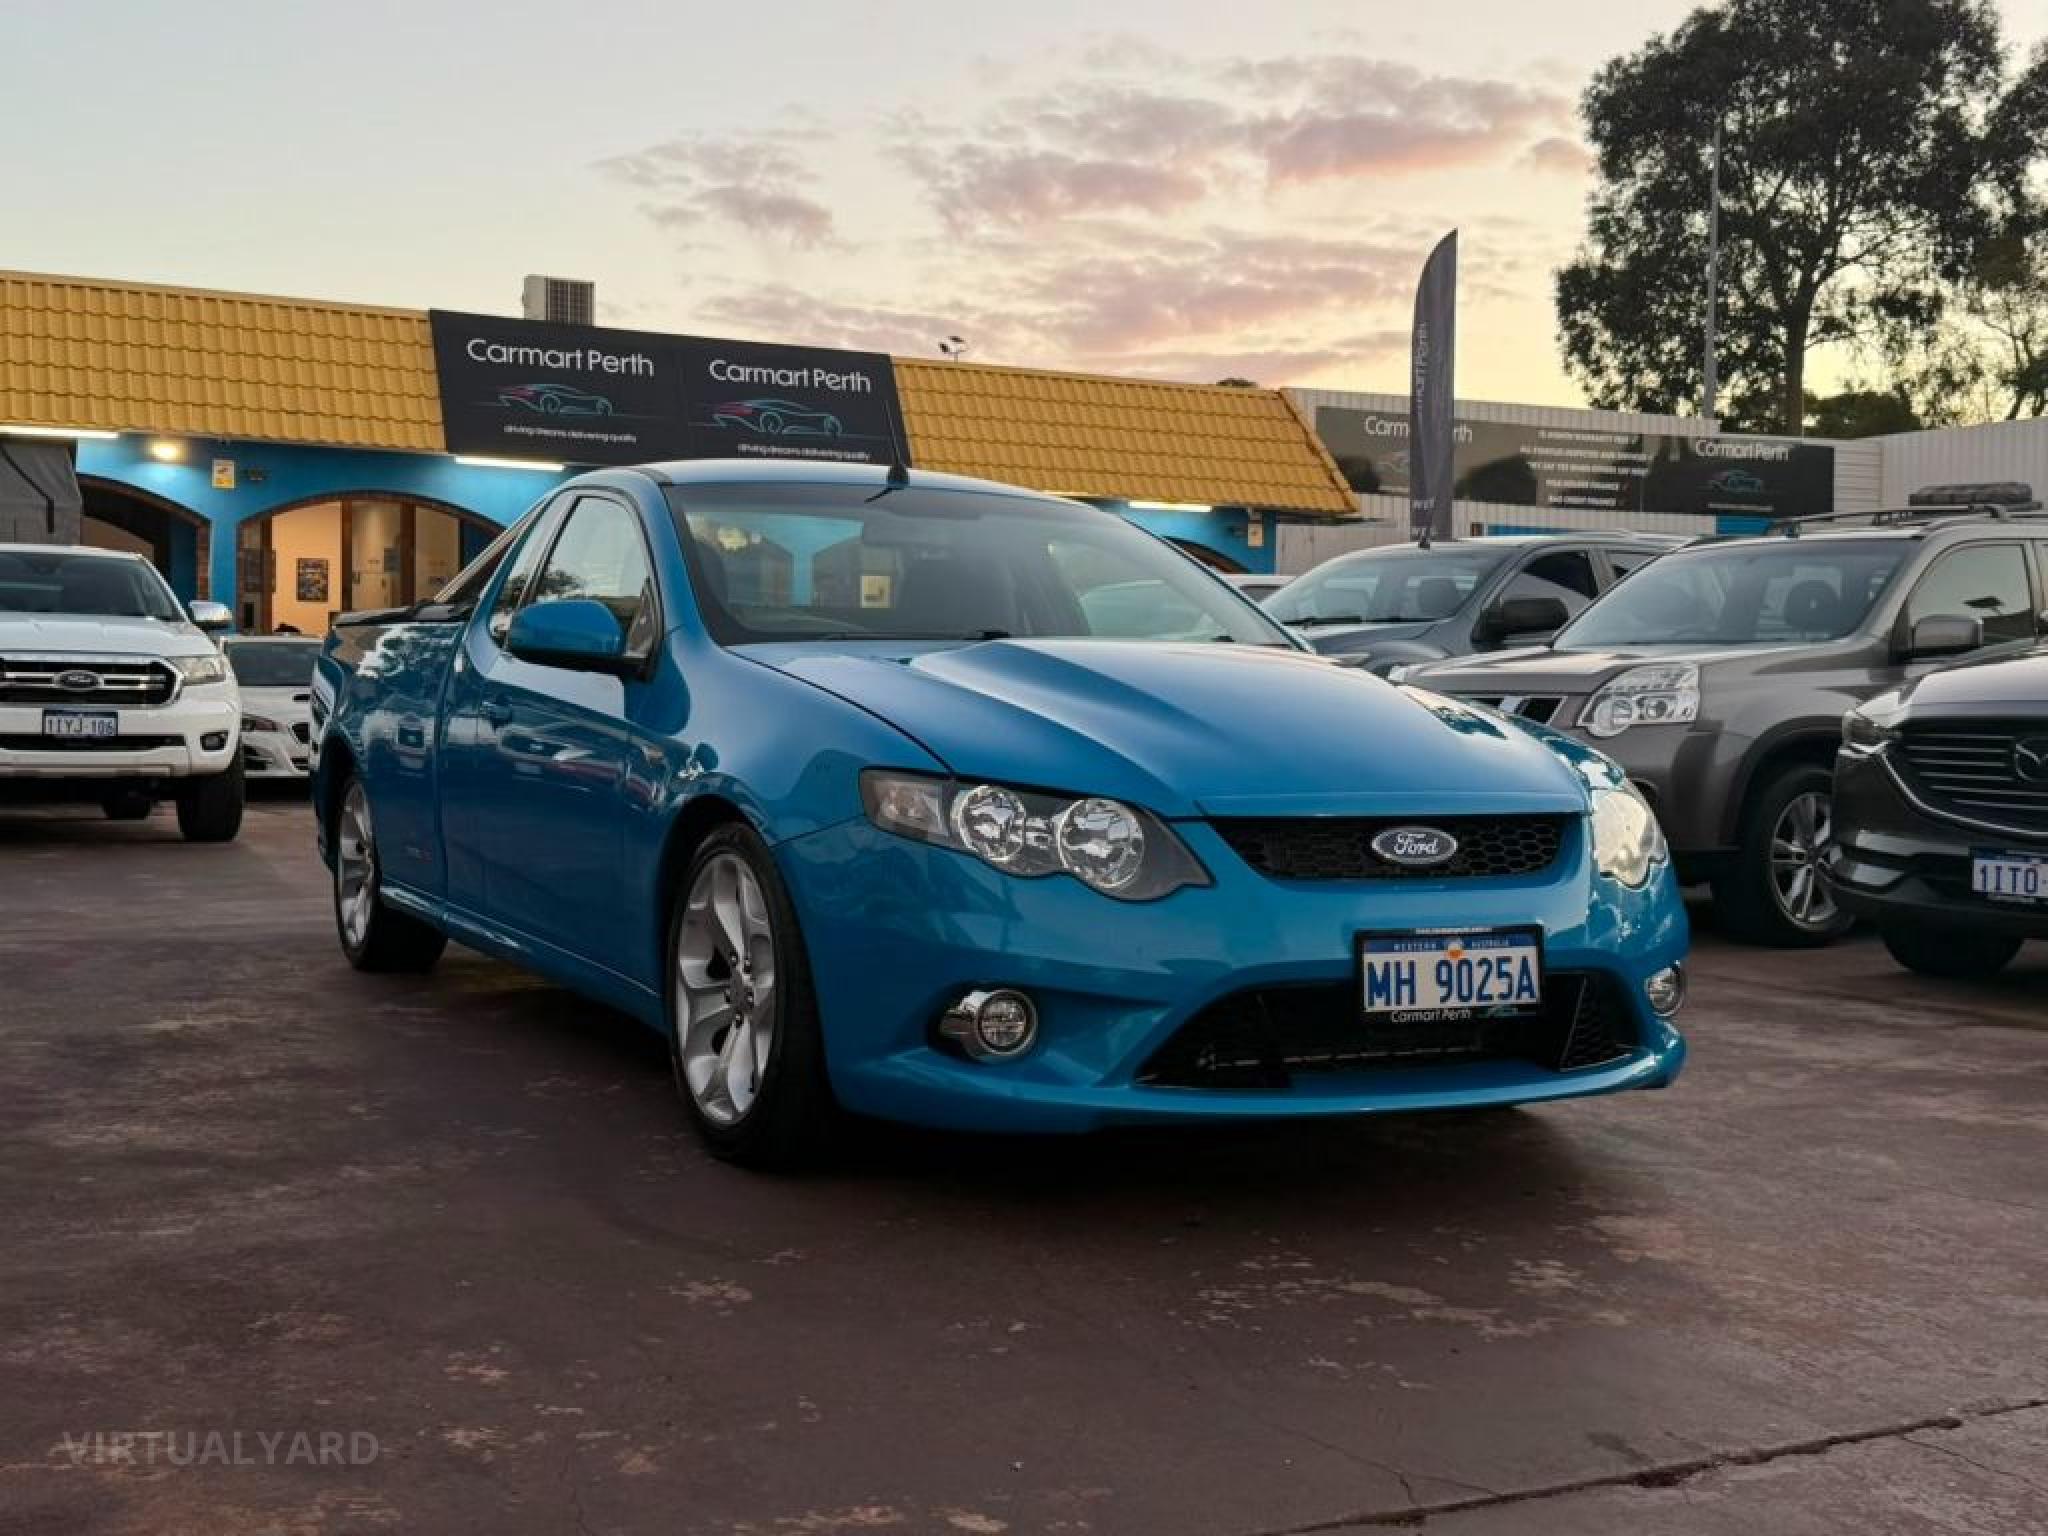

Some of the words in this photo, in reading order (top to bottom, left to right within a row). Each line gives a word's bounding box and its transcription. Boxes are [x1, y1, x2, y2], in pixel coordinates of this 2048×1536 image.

[466, 338, 583, 371] Carmart
[588, 350, 655, 377] Perth
[709, 359, 808, 389] Carmart
[814, 368, 872, 394] Perth
[1365, 416, 1410, 438] Carm
[1696, 439, 1753, 459] Carmart
[1755, 443, 1789, 461] Perth
[1394, 833, 1439, 855] Ford
[1366, 959, 1417, 1007] MH
[1435, 955, 1537, 1004] 9025A
[1391, 1009, 1440, 1023] Carmart
[1441, 1007, 1472, 1020] Perth
